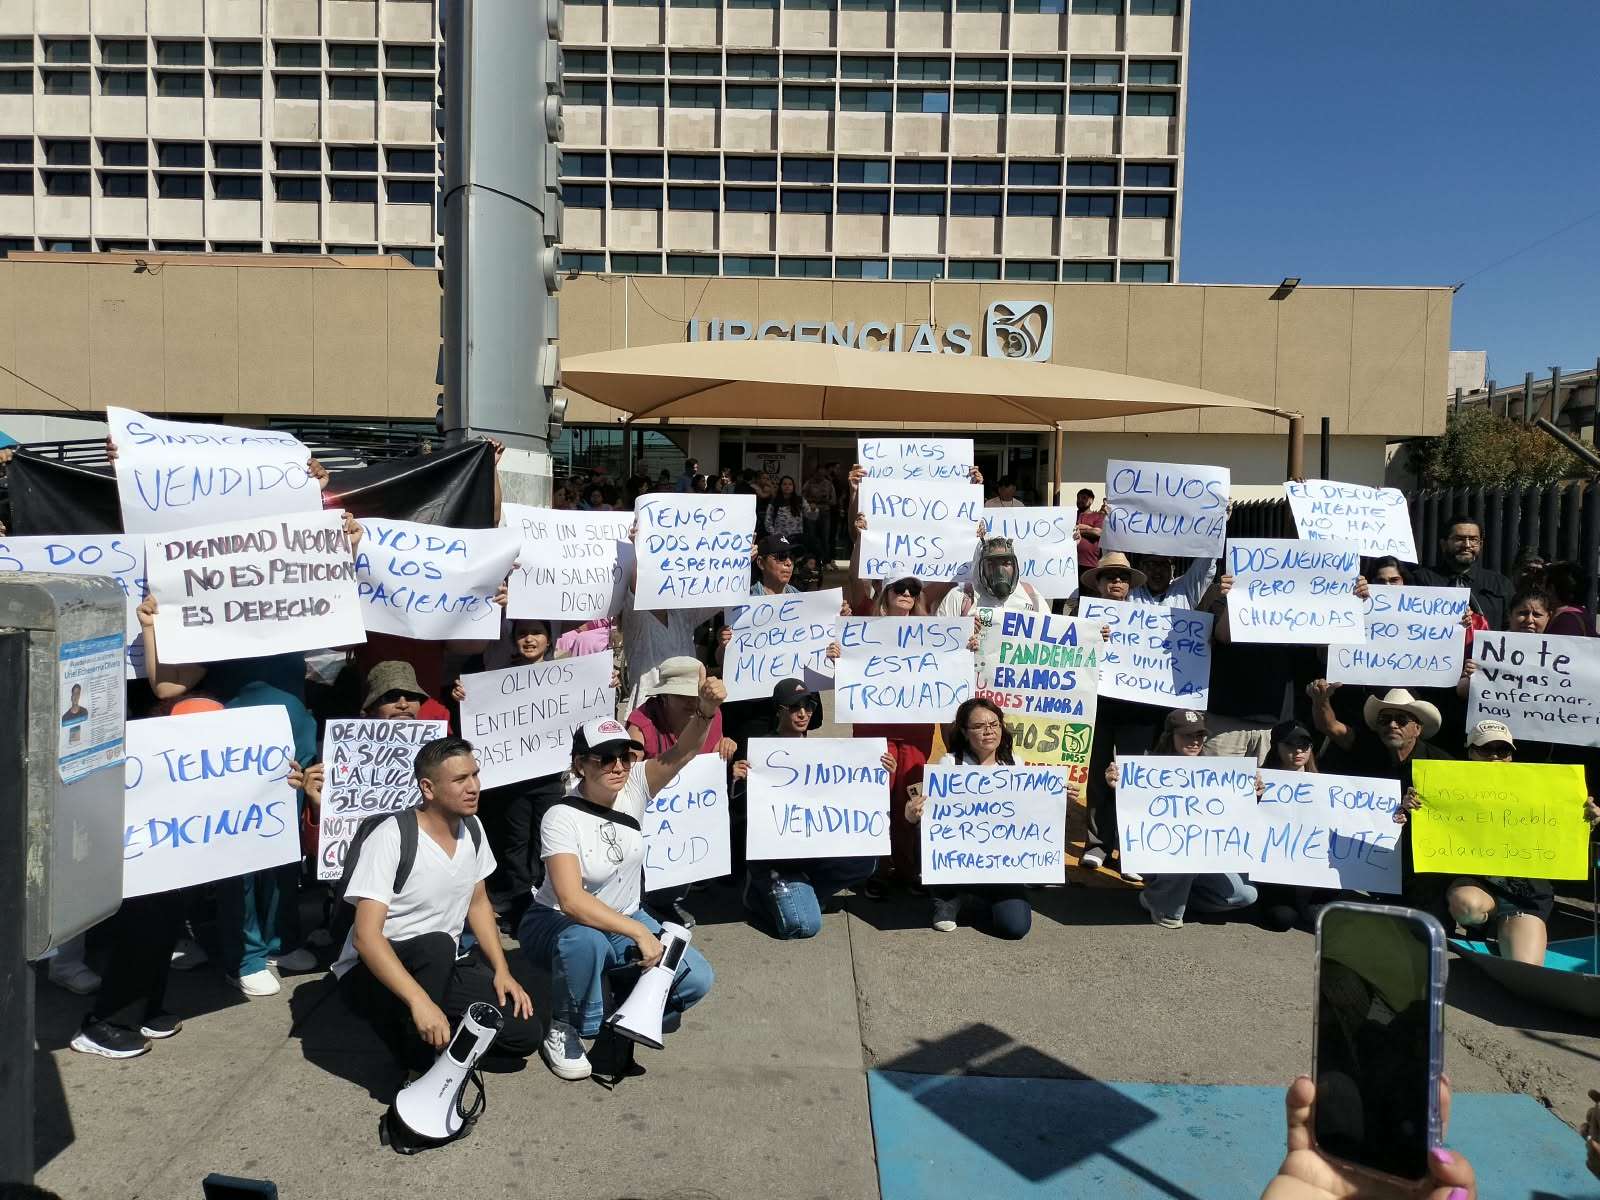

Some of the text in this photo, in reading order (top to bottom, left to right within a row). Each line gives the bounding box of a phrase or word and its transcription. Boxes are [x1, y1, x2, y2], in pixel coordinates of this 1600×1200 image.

[688, 316, 973, 357] URGENCIAS
[126, 422, 299, 447] SINDICATO
[862, 441, 945, 461] EL IMSS
[868, 463, 971, 480] NO SE VEND
[135, 461, 311, 512] VENDIDO
[1112, 468, 1222, 510] OLIVOS
[1290, 484, 1314, 499] EL
[640, 500, 727, 531] TENGO
[871, 491, 979, 523] APOYO AL
[1311, 501, 1386, 518] MIENTE
[521, 518, 547, 541] POR
[556, 522, 577, 540] UN
[1108, 507, 1225, 540] RENUNCIA
[1300, 517, 1387, 535] NO HAY
[561, 542, 604, 560] JUSTO
[645, 531, 754, 554] DOS AÑOS
[885, 531, 945, 560] IMSS
[1308, 529, 1411, 554] MEINAS
[44, 540, 137, 574] DOS
[355, 552, 443, 580] A LOS
[660, 555, 751, 572] ESPERAND
[1019, 556, 1076, 578] NCIA
[1230, 545, 1279, 576] DOS
[183, 566, 224, 598] NO
[230, 563, 265, 588] ES
[521, 563, 624, 586] Y UN SALARIO
[357, 581, 494, 622] PACIENTES
[561, 591, 605, 612] DIGNO
[1247, 579, 1296, 599] PERO
[181, 604, 214, 628] ES
[731, 600, 804, 631] ZOE
[1084, 603, 1205, 639] ES MEJOR
[1238, 605, 1357, 630] CHINGONAS
[841, 620, 962, 653] EL IMSS
[1001, 611, 1078, 647] EN LA
[1109, 631, 1141, 646] RIR
[1148, 636, 1172, 650] DE
[1363, 622, 1455, 641] RO BIEN
[864, 652, 939, 678] ESTA
[1133, 652, 1182, 673] VIVIR
[1337, 648, 1453, 672] CHINGONAS
[1480, 635, 1571, 675] No te
[500, 663, 574, 695] OLIVOS
[993, 667, 1077, 691] ERAMOS
[1115, 672, 1205, 699] RODILLAS
[1559, 678, 1572, 688] a
[837, 679, 970, 711] TRONADO
[1025, 695, 1035, 713] Y
[1037, 695, 1084, 716] AHORA
[475, 693, 570, 737] ENTIENDE
[582, 686, 607, 710] LA
[1478, 702, 1600, 724] hay materi
[519, 734, 541, 756] NO
[543, 729, 565, 751] SE
[1005, 721, 1061, 753] MOS
[123, 754, 144, 790] O
[154, 743, 292, 783] TENEMOS
[333, 743, 411, 769] A SUR
[765, 749, 889, 788] SINDICATO
[1061, 752, 1086, 763] IMSS
[331, 766, 418, 787] LA LUC
[927, 768, 1066, 799] NECESITAMOS
[1120, 761, 1258, 797] NECESITAMOS
[931, 801, 1016, 820] INSUMOS
[1148, 793, 1226, 819] OTRO
[1258, 781, 1398, 815] ZOE ROBLED
[1475, 810, 1495, 824] El
[1503, 803, 1559, 828] Pueblo
[122, 800, 287, 861] EDICINAS
[929, 821, 1054, 844] PERSONAL
[1125, 821, 1256, 861] HOSPITAL
[645, 836, 710, 871] LUD
[1417, 832, 1558, 861] Salario Justo
[931, 849, 1062, 872] INFRAESTRUCTURA
